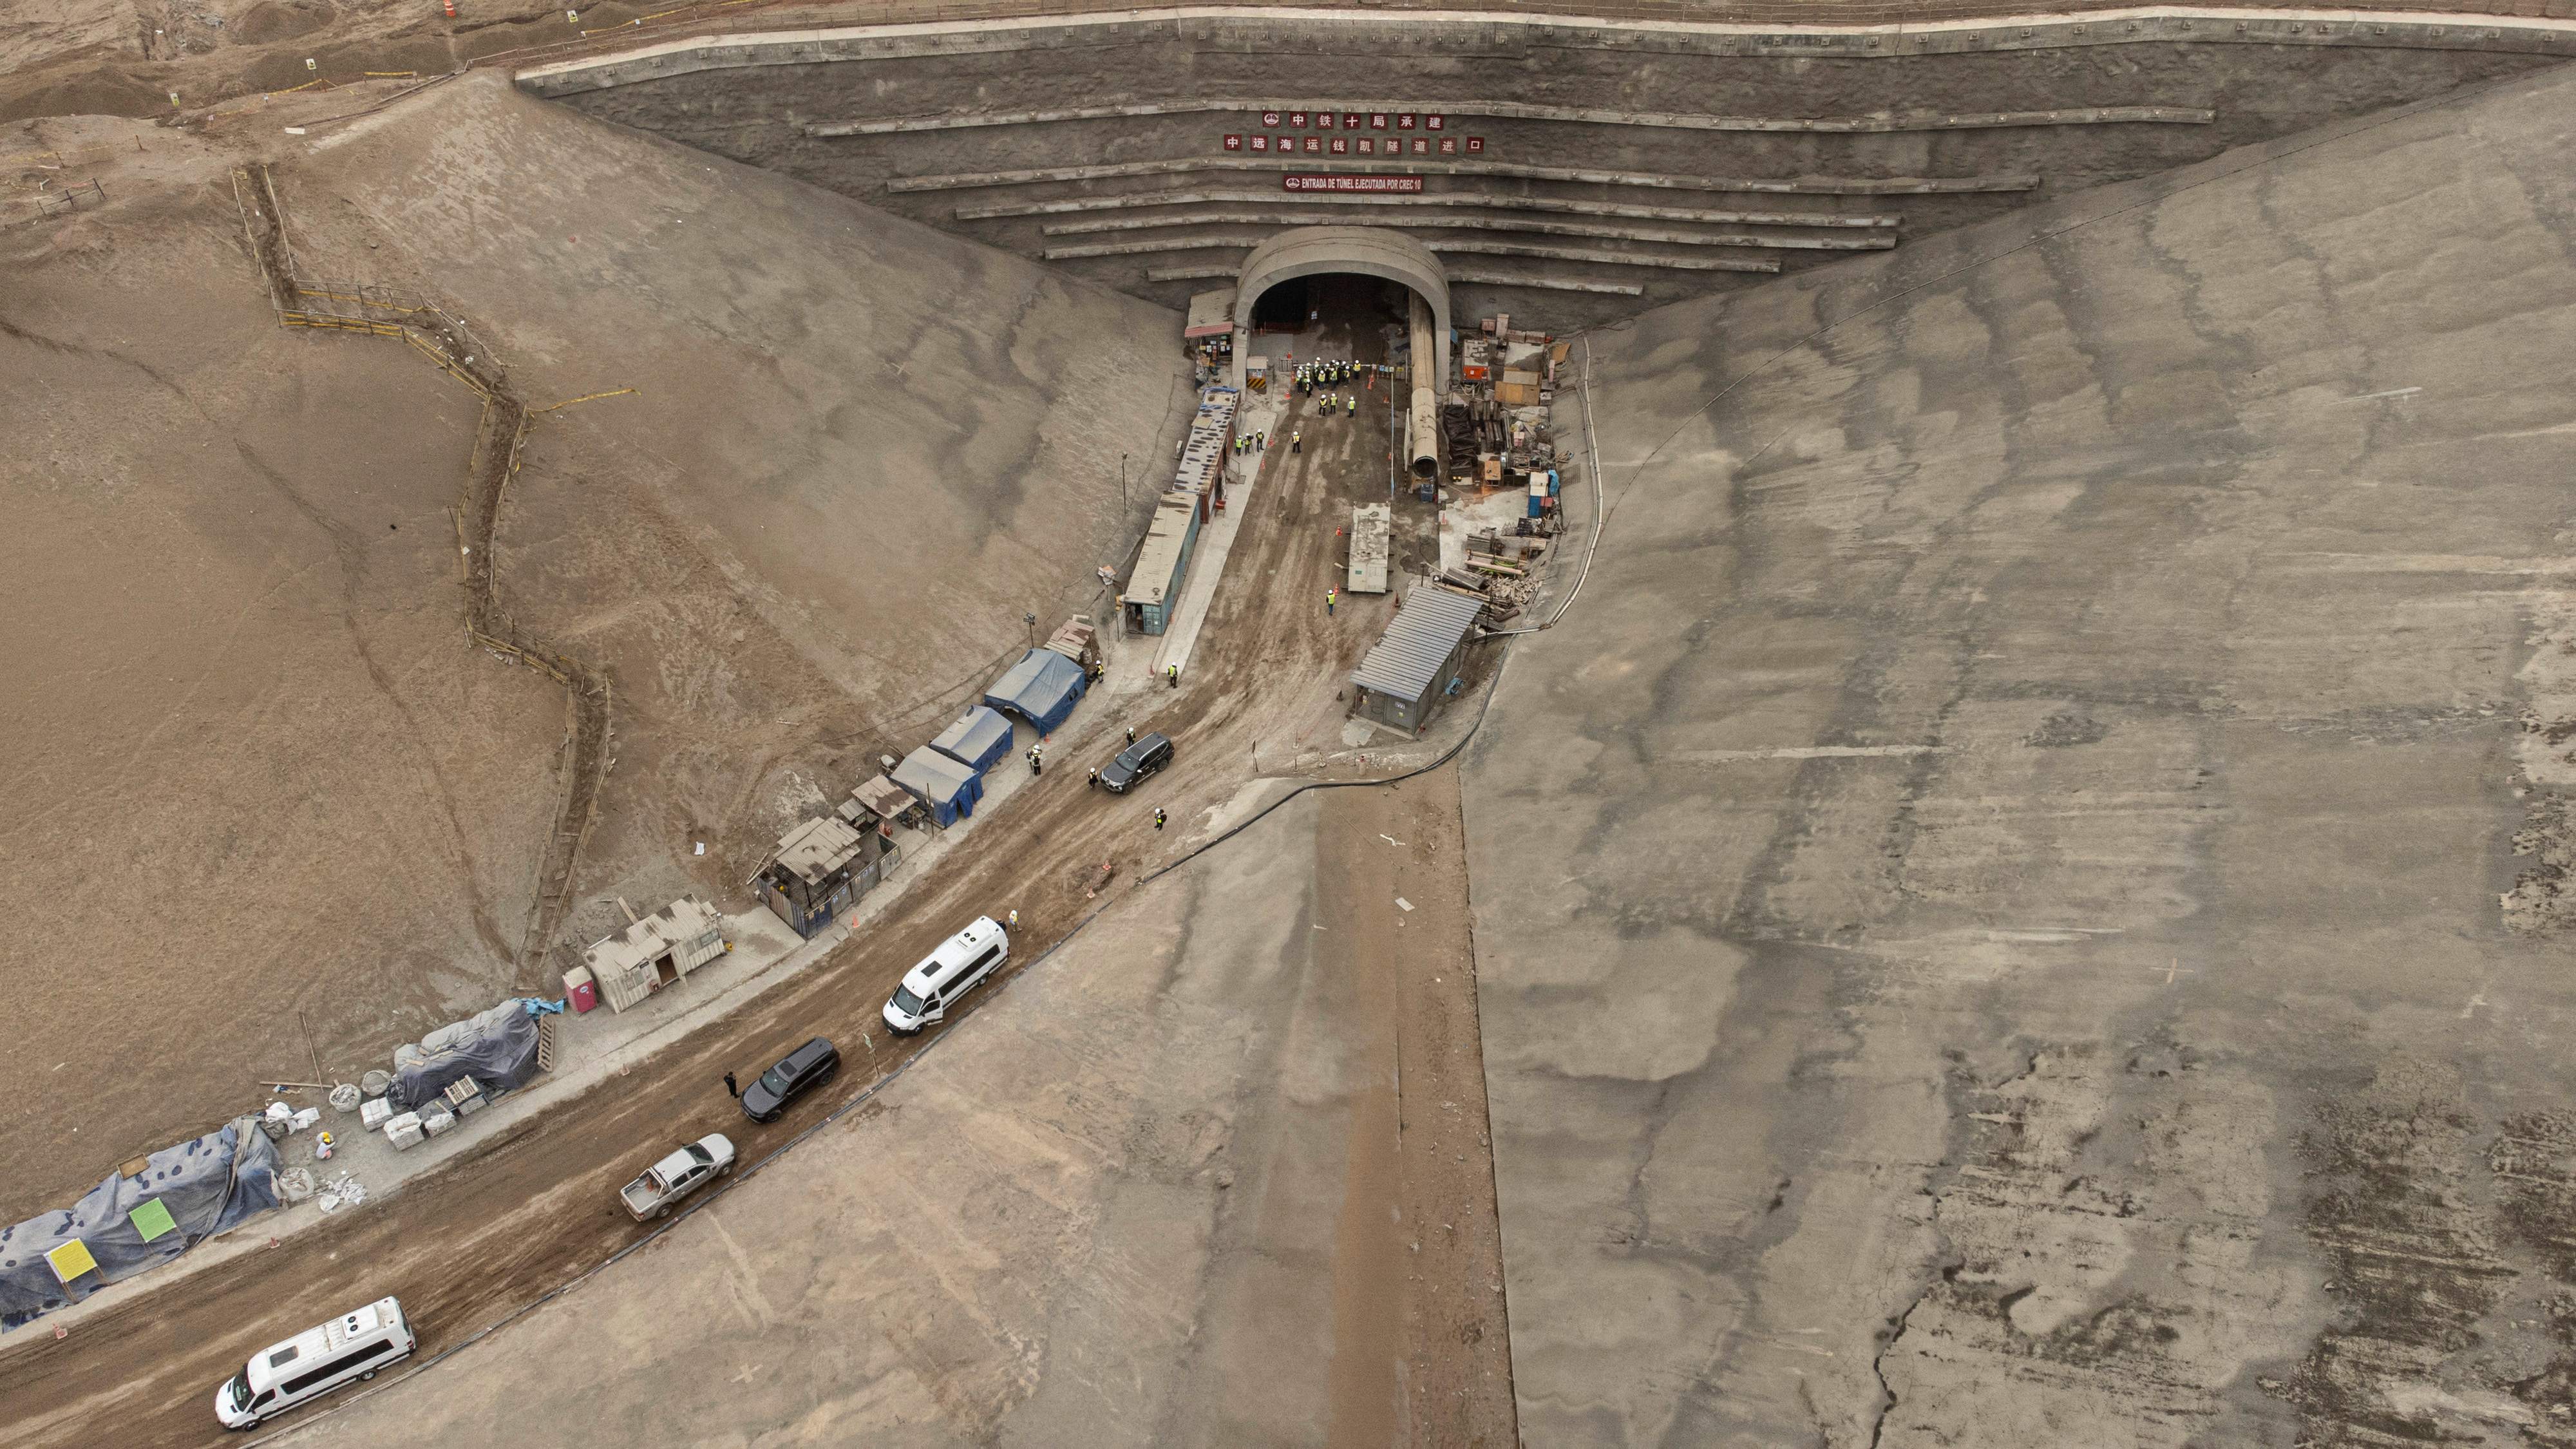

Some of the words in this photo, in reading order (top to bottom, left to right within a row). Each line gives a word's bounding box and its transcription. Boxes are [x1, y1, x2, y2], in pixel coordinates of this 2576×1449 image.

[1293, 114, 1440, 128] 中铁十局承建
[1227, 137, 1480, 152] 中远海运钱凯隧道进口
[1302, 178, 1327, 188] ENTRADA
[1328, 178, 1335, 188] DE
[1336, 176, 1354, 189] TÚNEL
[1355, 178, 1386, 189] EJECUTADA
[1387, 179, 1398, 189] POR
[1399, 179, 1414, 190] CREC
[1415, 180, 1421, 189] 10
